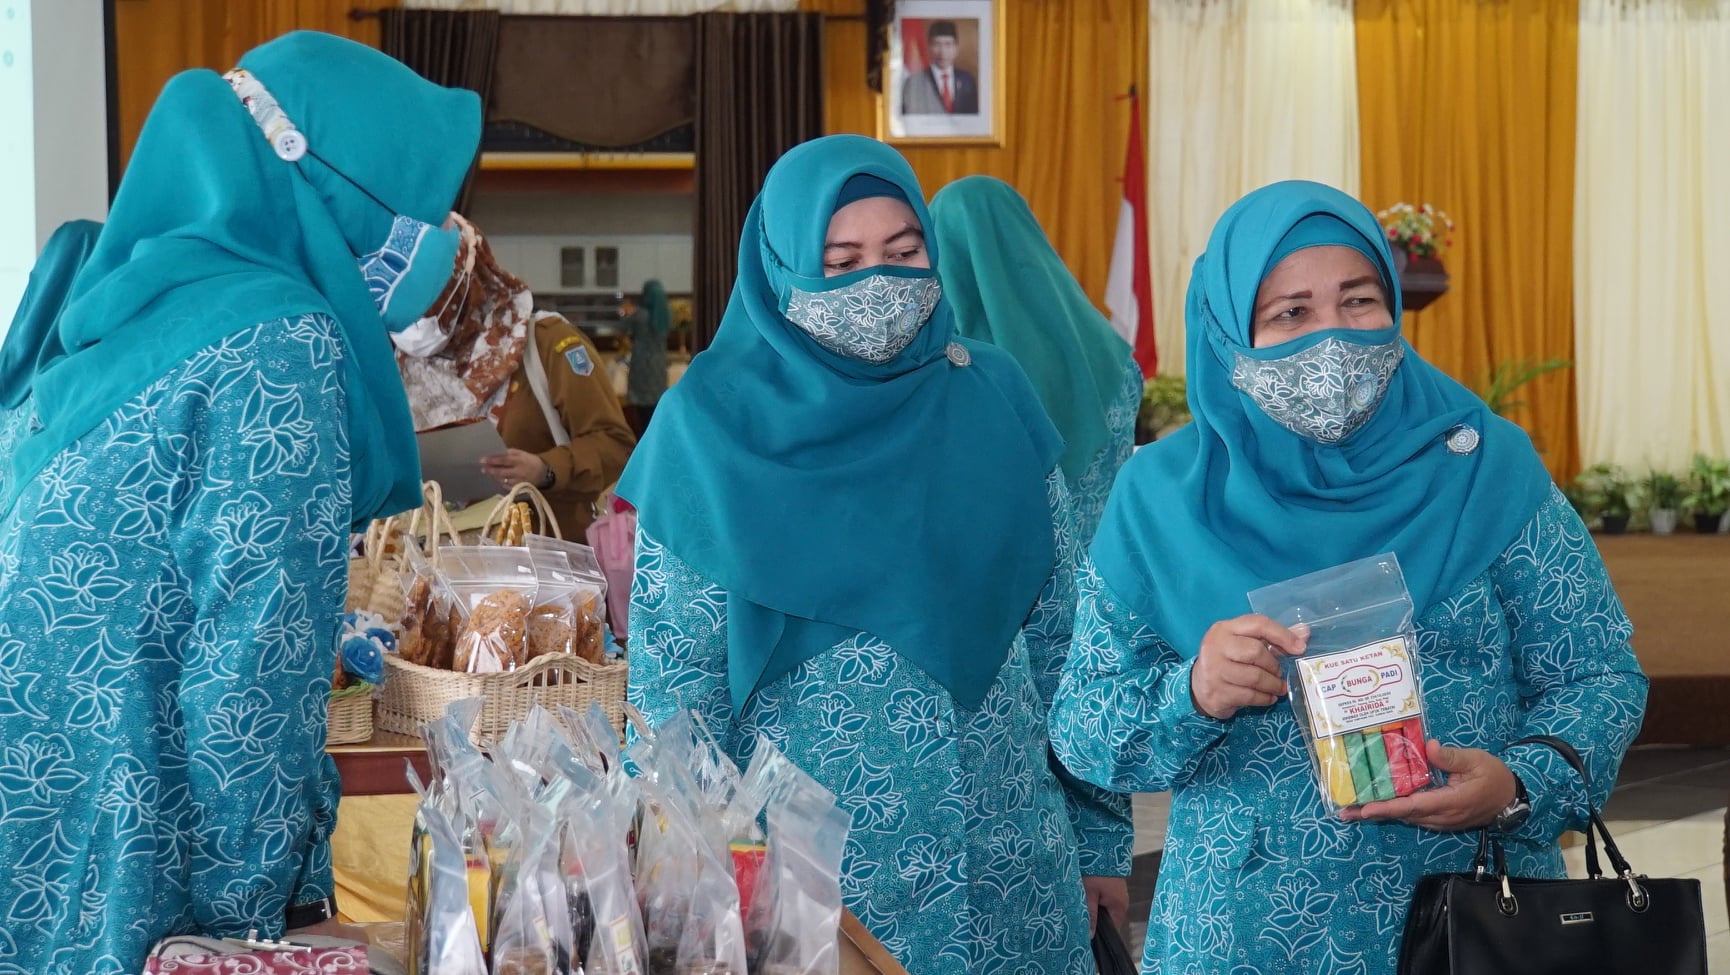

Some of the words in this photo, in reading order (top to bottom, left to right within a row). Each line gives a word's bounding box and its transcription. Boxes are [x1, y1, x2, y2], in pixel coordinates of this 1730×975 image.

[1341, 657, 1358, 665] SATU
[1360, 651, 1383, 661] KETAN
[1321, 684, 1336, 693] CAP
[1346, 676, 1372, 687] BUNGA
[1381, 670, 1398, 679] PADI
